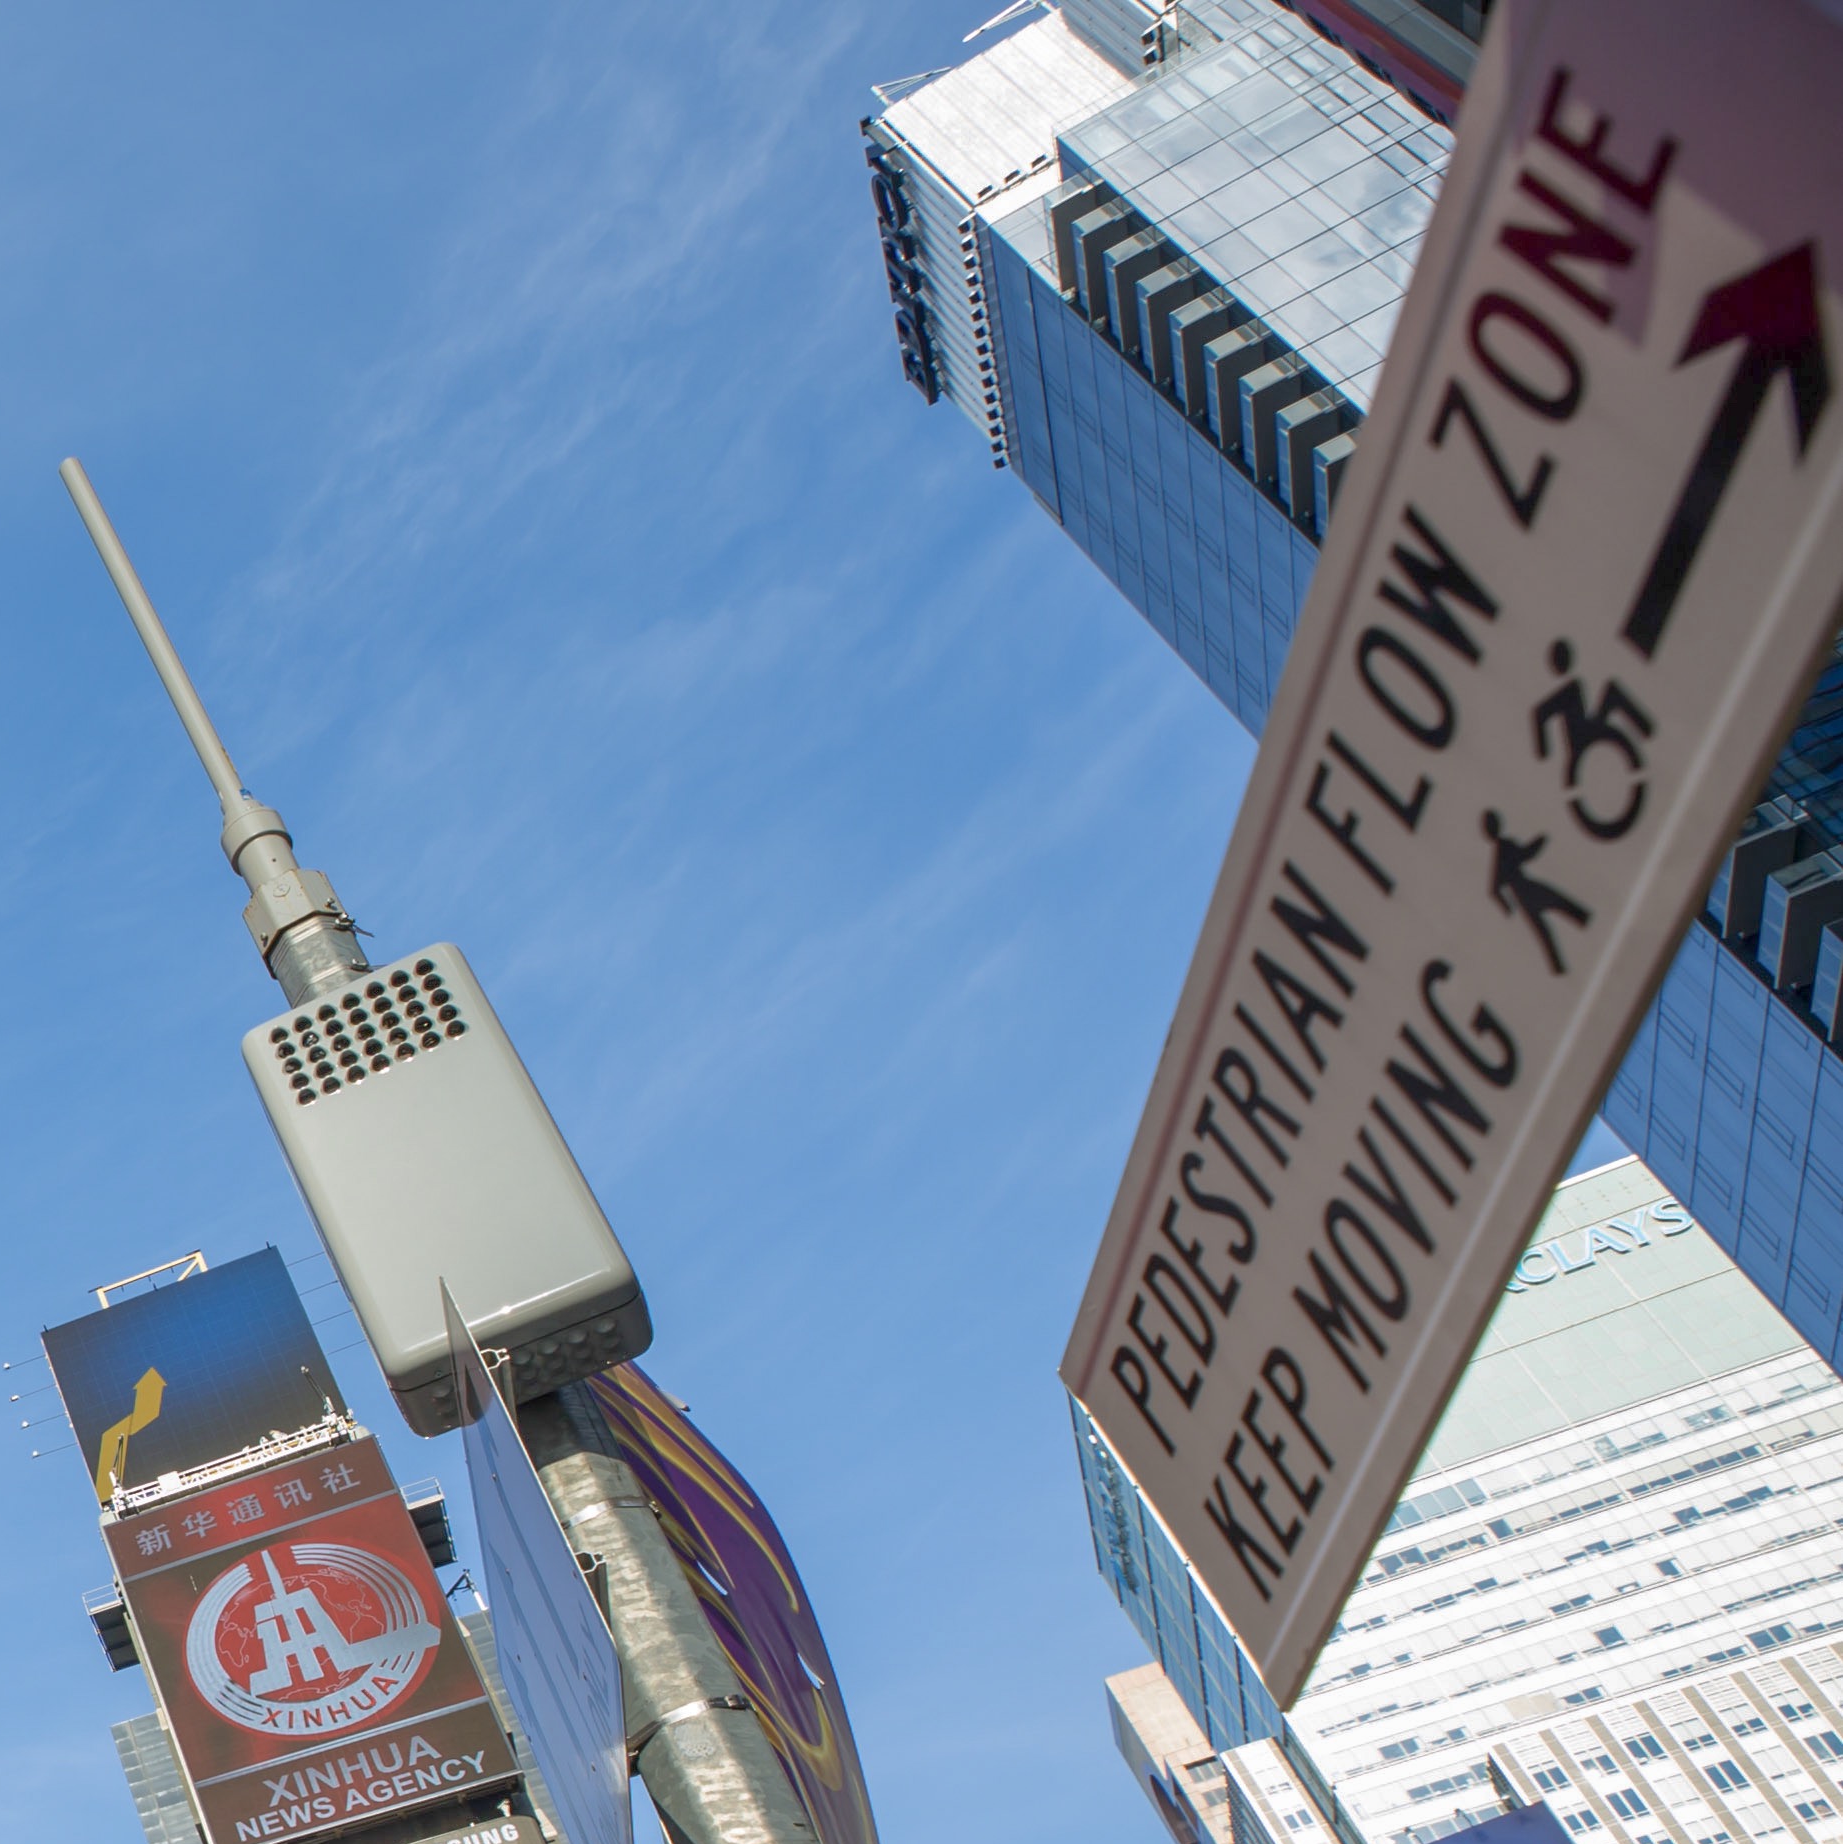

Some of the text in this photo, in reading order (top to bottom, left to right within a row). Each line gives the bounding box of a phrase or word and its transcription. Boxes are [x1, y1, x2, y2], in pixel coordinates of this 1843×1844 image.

[1109, 66, 1680, 1459] PEDESTRIAN FLOW ZONE
[1203, 959, 1522, 1605] KEEP MOVING
[133, 1464, 364, 1558] 新华通讯社
[262, 1676, 403, 1732] XINHUA
[235, 1749, 488, 1844] NEWS AGENCY
[260, 1731, 443, 1809] XINHUA
